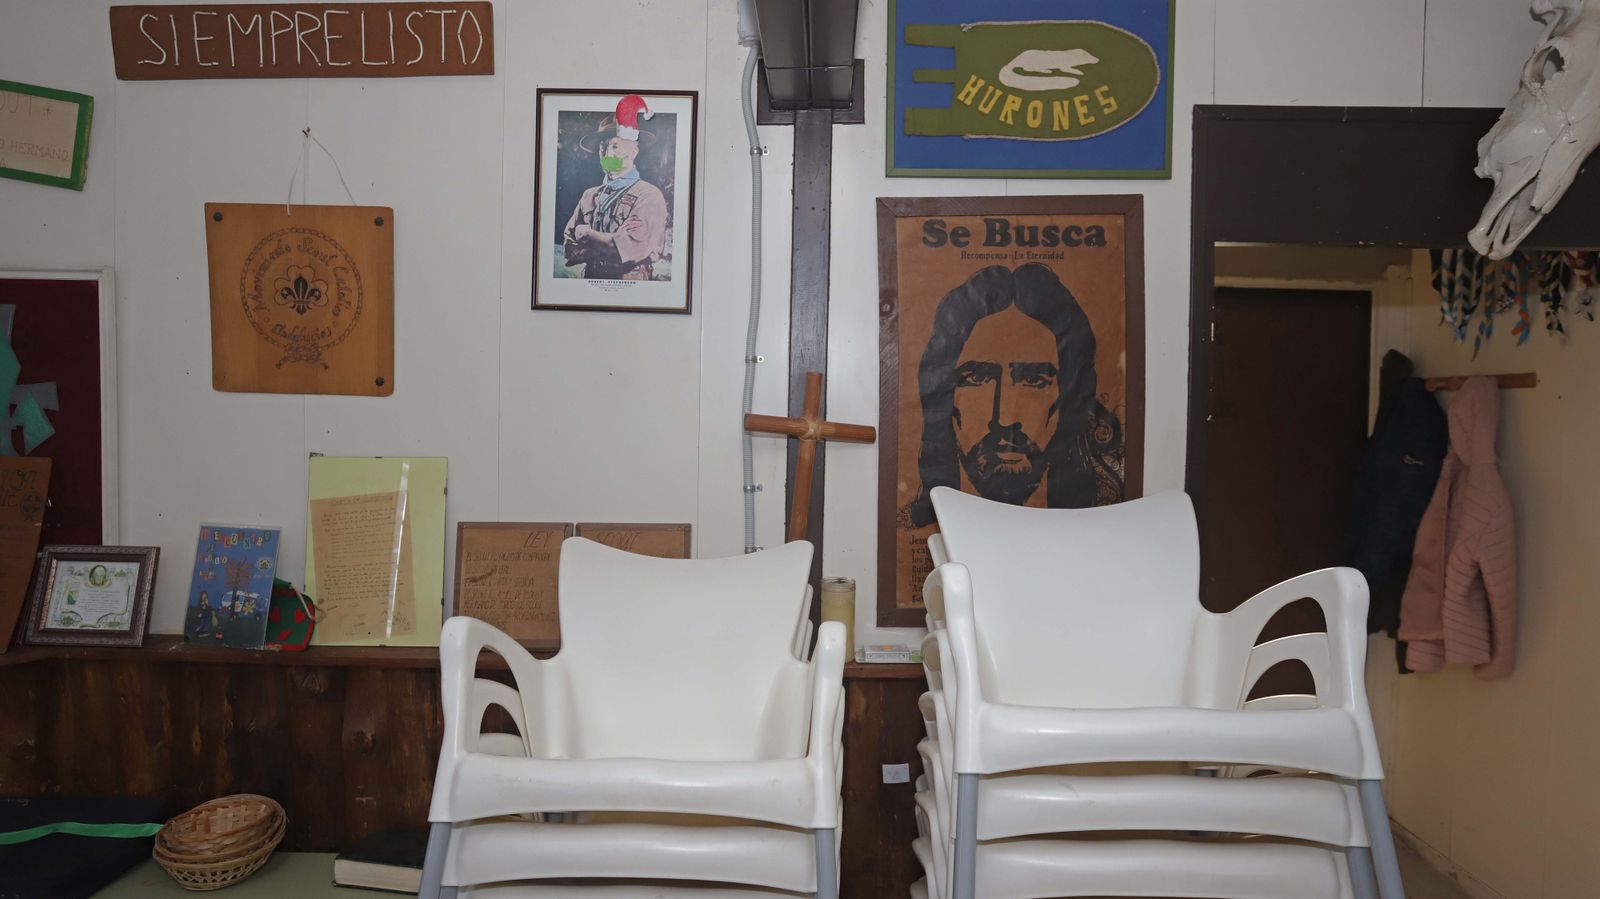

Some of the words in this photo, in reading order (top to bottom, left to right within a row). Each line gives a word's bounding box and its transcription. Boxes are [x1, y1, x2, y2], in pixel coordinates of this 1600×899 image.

[957, 74, 1119, 131] HURONES
[922, 218, 971, 249] Se
[983, 217, 1107, 248] Busca
[523, 530, 553, 549] LEY
